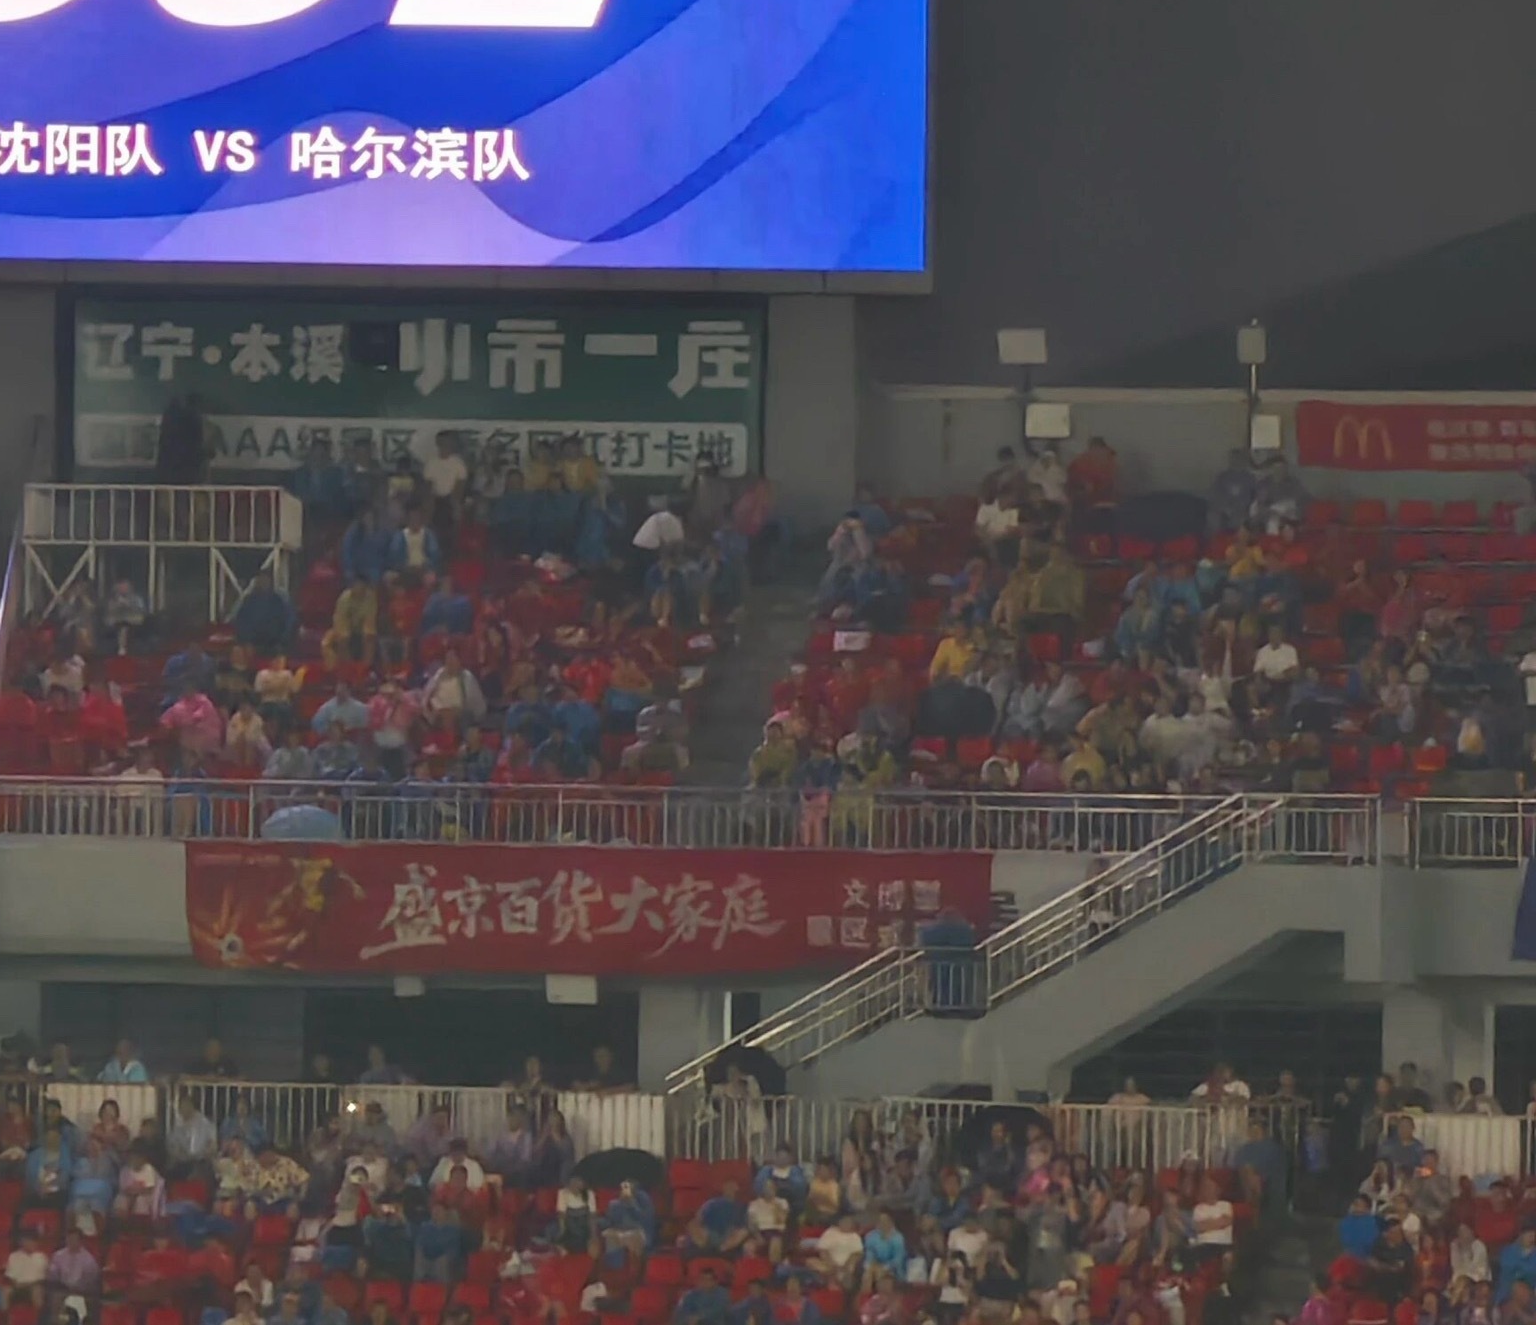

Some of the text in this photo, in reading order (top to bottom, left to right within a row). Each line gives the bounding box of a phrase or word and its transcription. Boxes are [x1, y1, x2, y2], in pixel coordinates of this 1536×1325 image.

[195, 130, 255, 173] VS
[291, 126, 530, 182] 哈尔滨队
